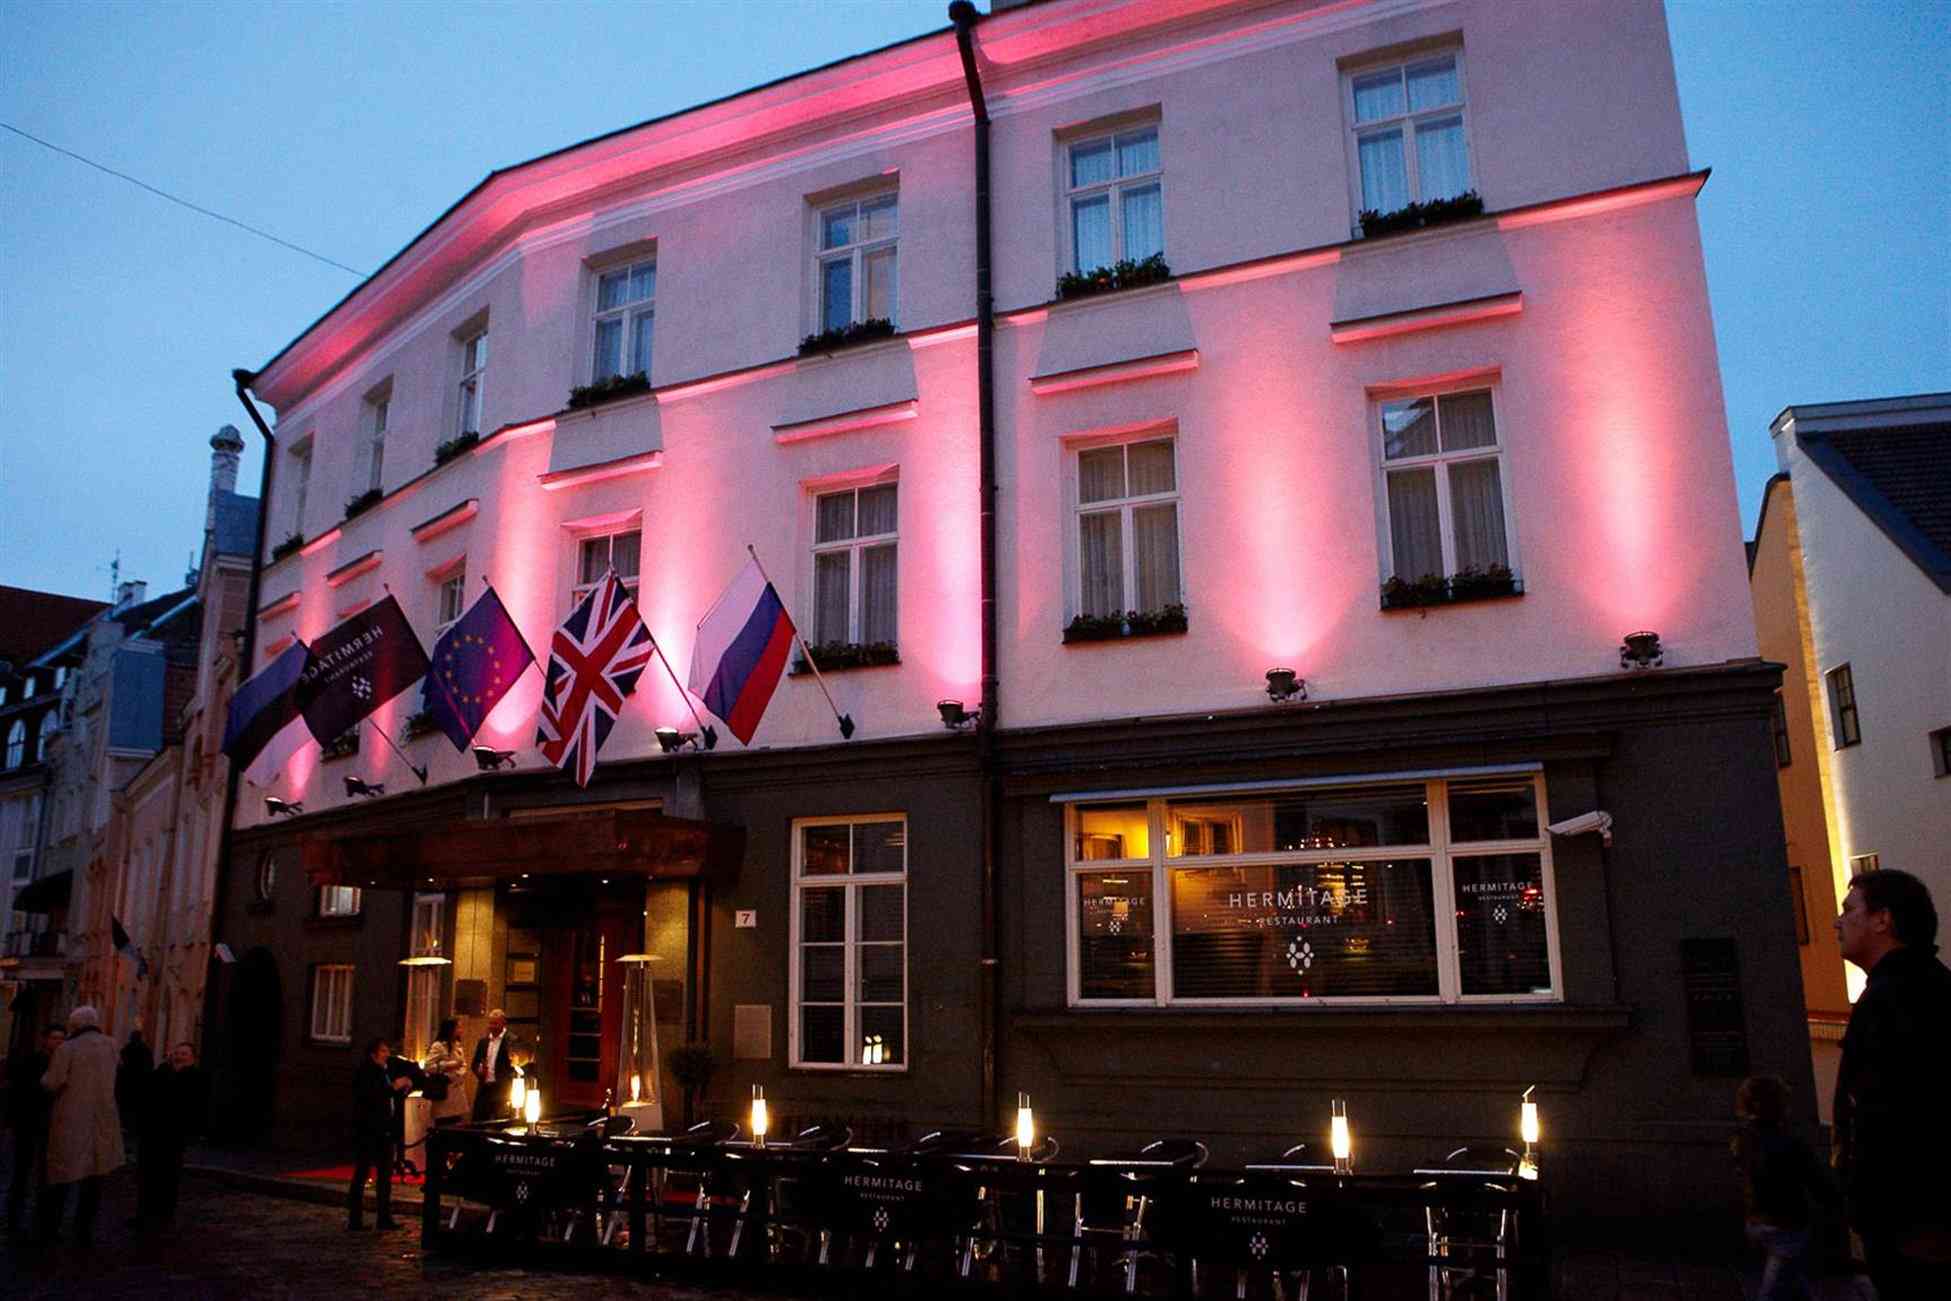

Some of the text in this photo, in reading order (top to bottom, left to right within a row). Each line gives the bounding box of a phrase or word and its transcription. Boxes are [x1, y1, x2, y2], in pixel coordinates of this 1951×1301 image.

[1461, 881, 1533, 893] HERMITAGE
[1229, 888, 1369, 908] HERMITAGE
[741, 912, 751, 925] 7
[842, 1175, 923, 1192] HERMITAGE
[1210, 1196, 1308, 1215] HERMITAGE
